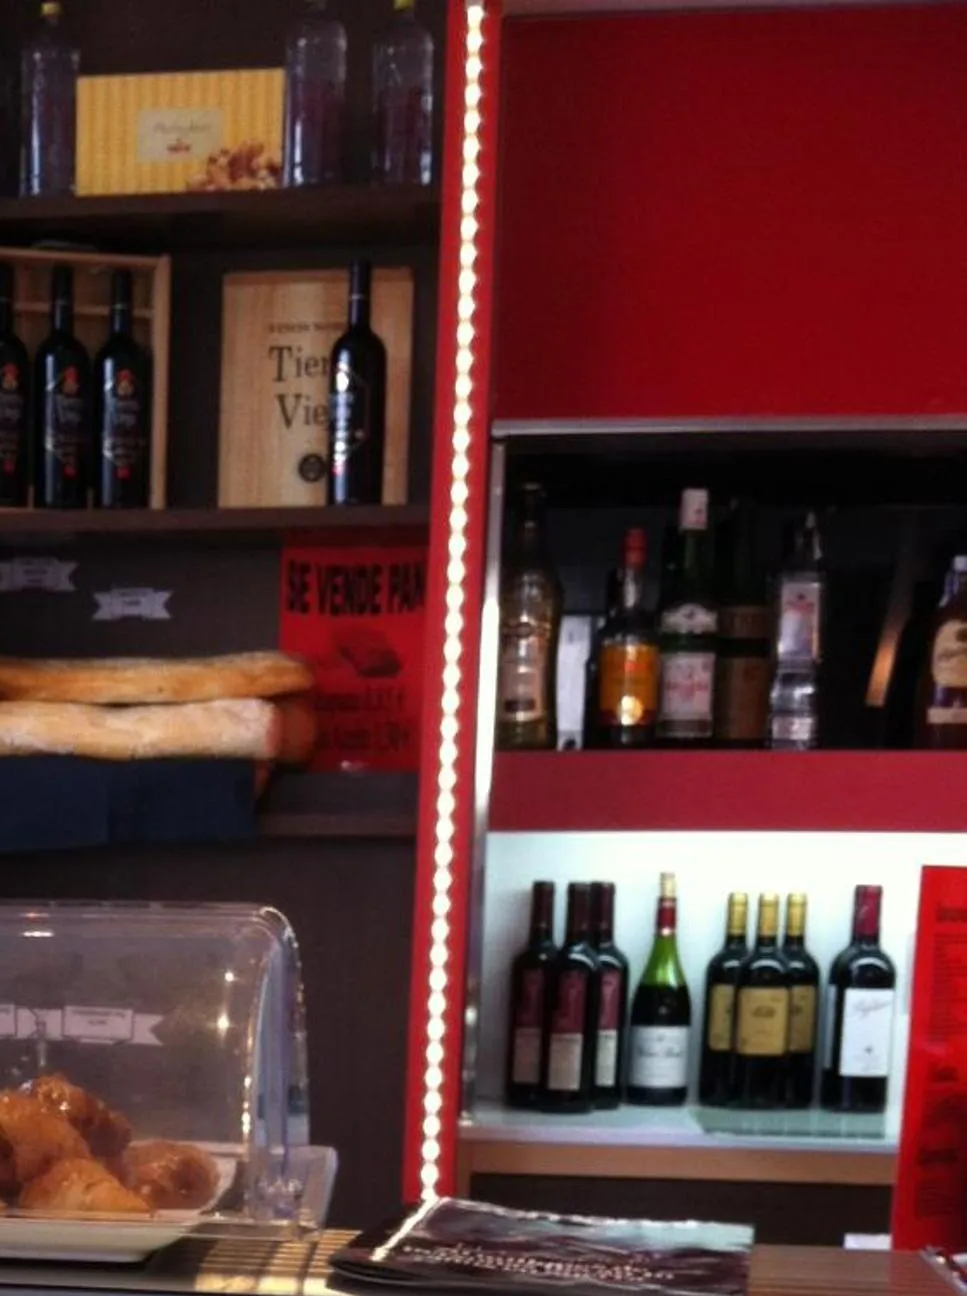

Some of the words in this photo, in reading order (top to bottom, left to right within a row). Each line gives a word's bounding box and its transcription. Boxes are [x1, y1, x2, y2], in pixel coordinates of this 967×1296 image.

[268, 345, 331, 383] Tier
[275, 392, 330, 431] Vie
[288, 559, 311, 615] SE
[315, 562, 383, 617] VENDE
[387, 559, 426, 615] PAN
